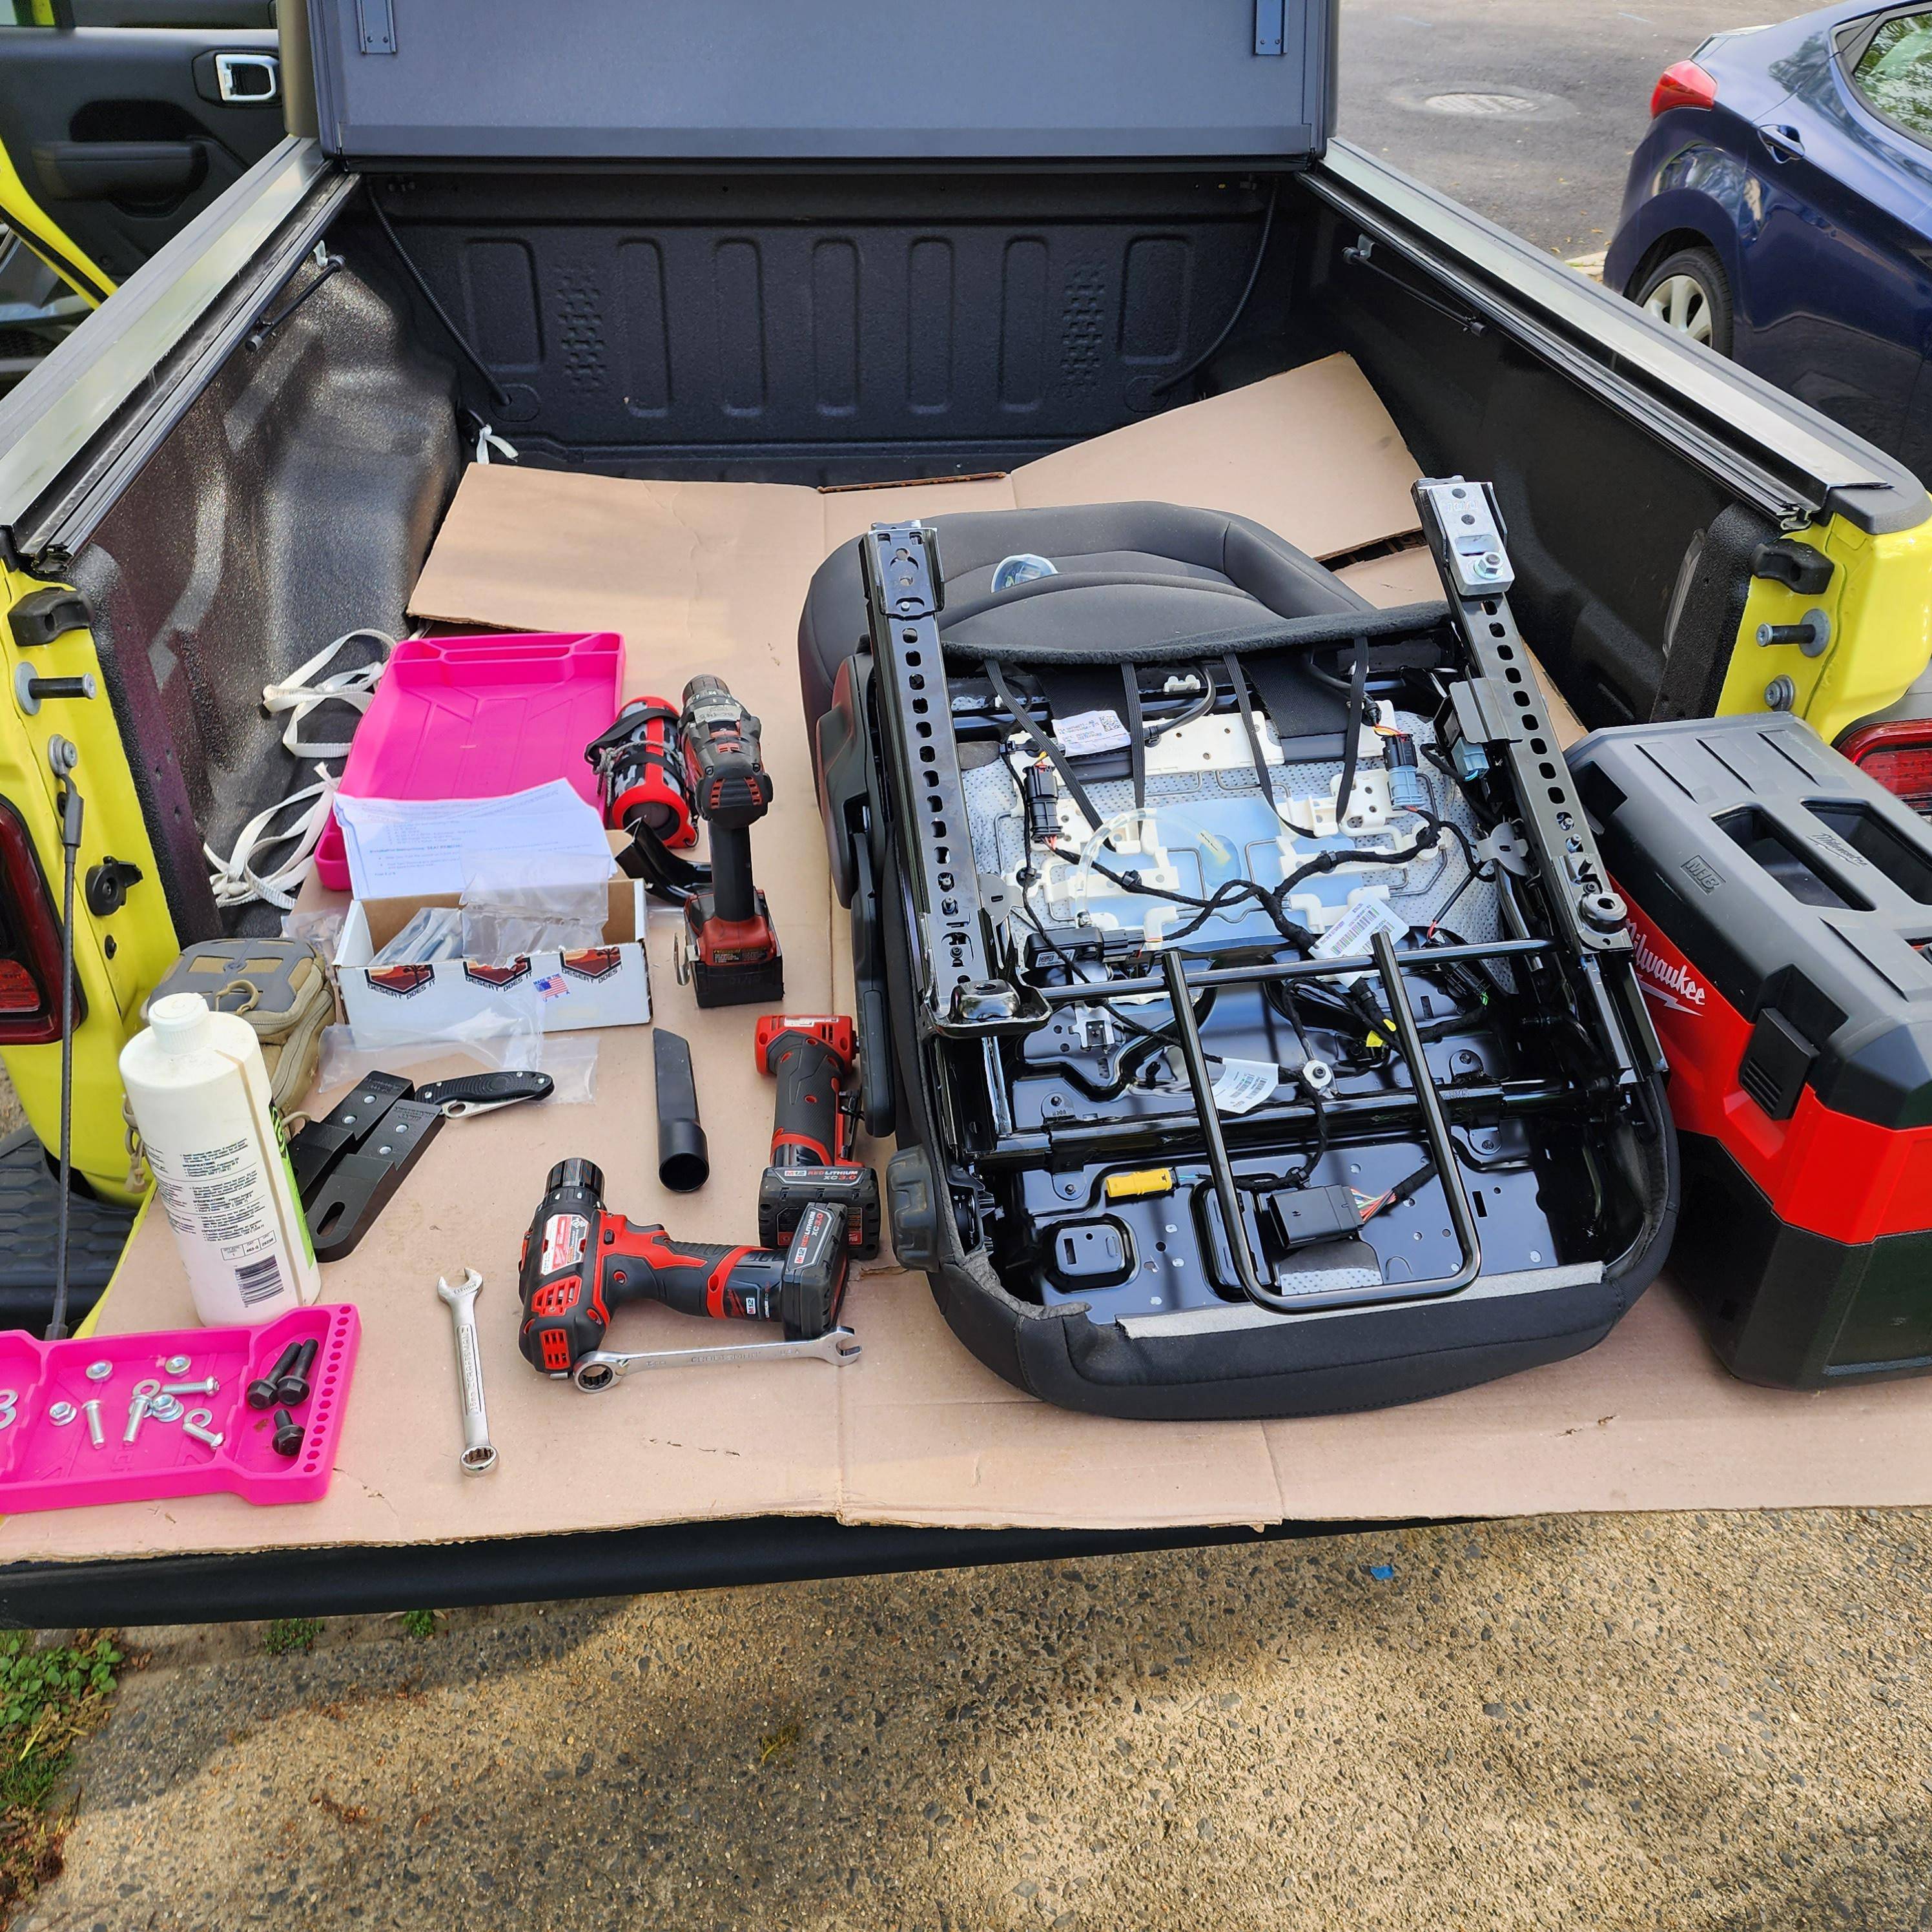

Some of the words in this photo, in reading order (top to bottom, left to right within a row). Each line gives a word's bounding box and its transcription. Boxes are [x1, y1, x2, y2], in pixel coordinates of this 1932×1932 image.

[562, 969, 595, 983] DESERT
[598, 967, 618, 984] DOES
[367, 983, 403, 1000] DESERT
[406, 985, 427, 1000] DOES
[429, 978, 436, 987] IT
[465, 976, 500, 992] DESERT
[503, 976, 523, 992] DOES
[796, 1248, 807, 1263] M12
